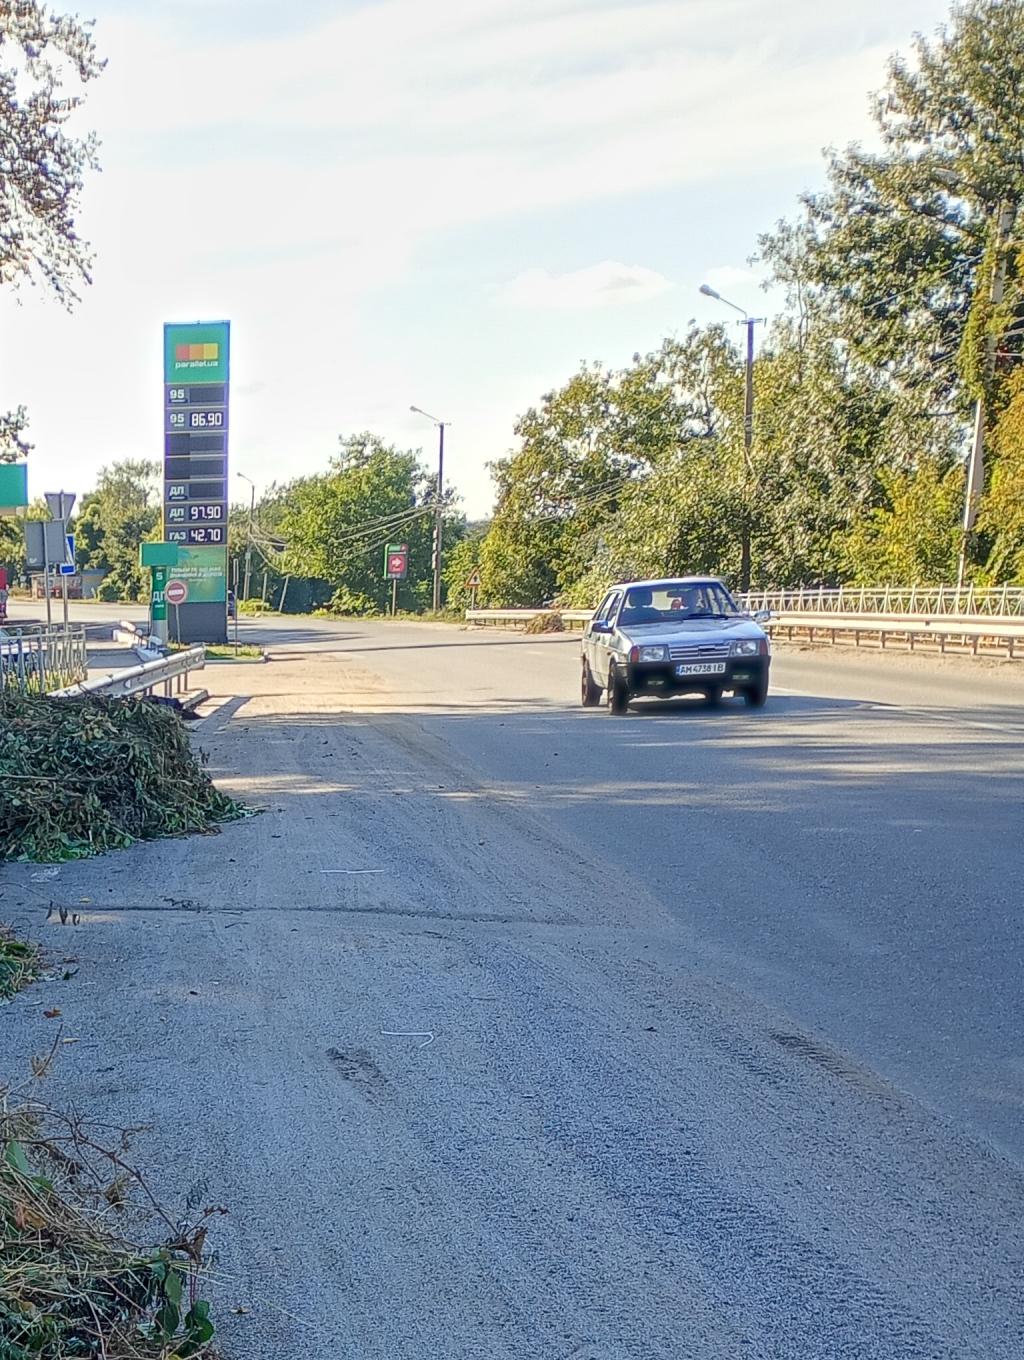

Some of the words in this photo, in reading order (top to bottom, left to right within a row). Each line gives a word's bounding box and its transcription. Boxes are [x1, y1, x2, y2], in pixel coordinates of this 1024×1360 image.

[170, 389, 185, 399] 95
[170, 413, 185, 423] 95
[191, 413, 222, 427] 86.90
[191, 505, 221, 520] 97.90
[169, 531, 186, 541] ГАЗ
[191, 528, 221, 542] 42.70
